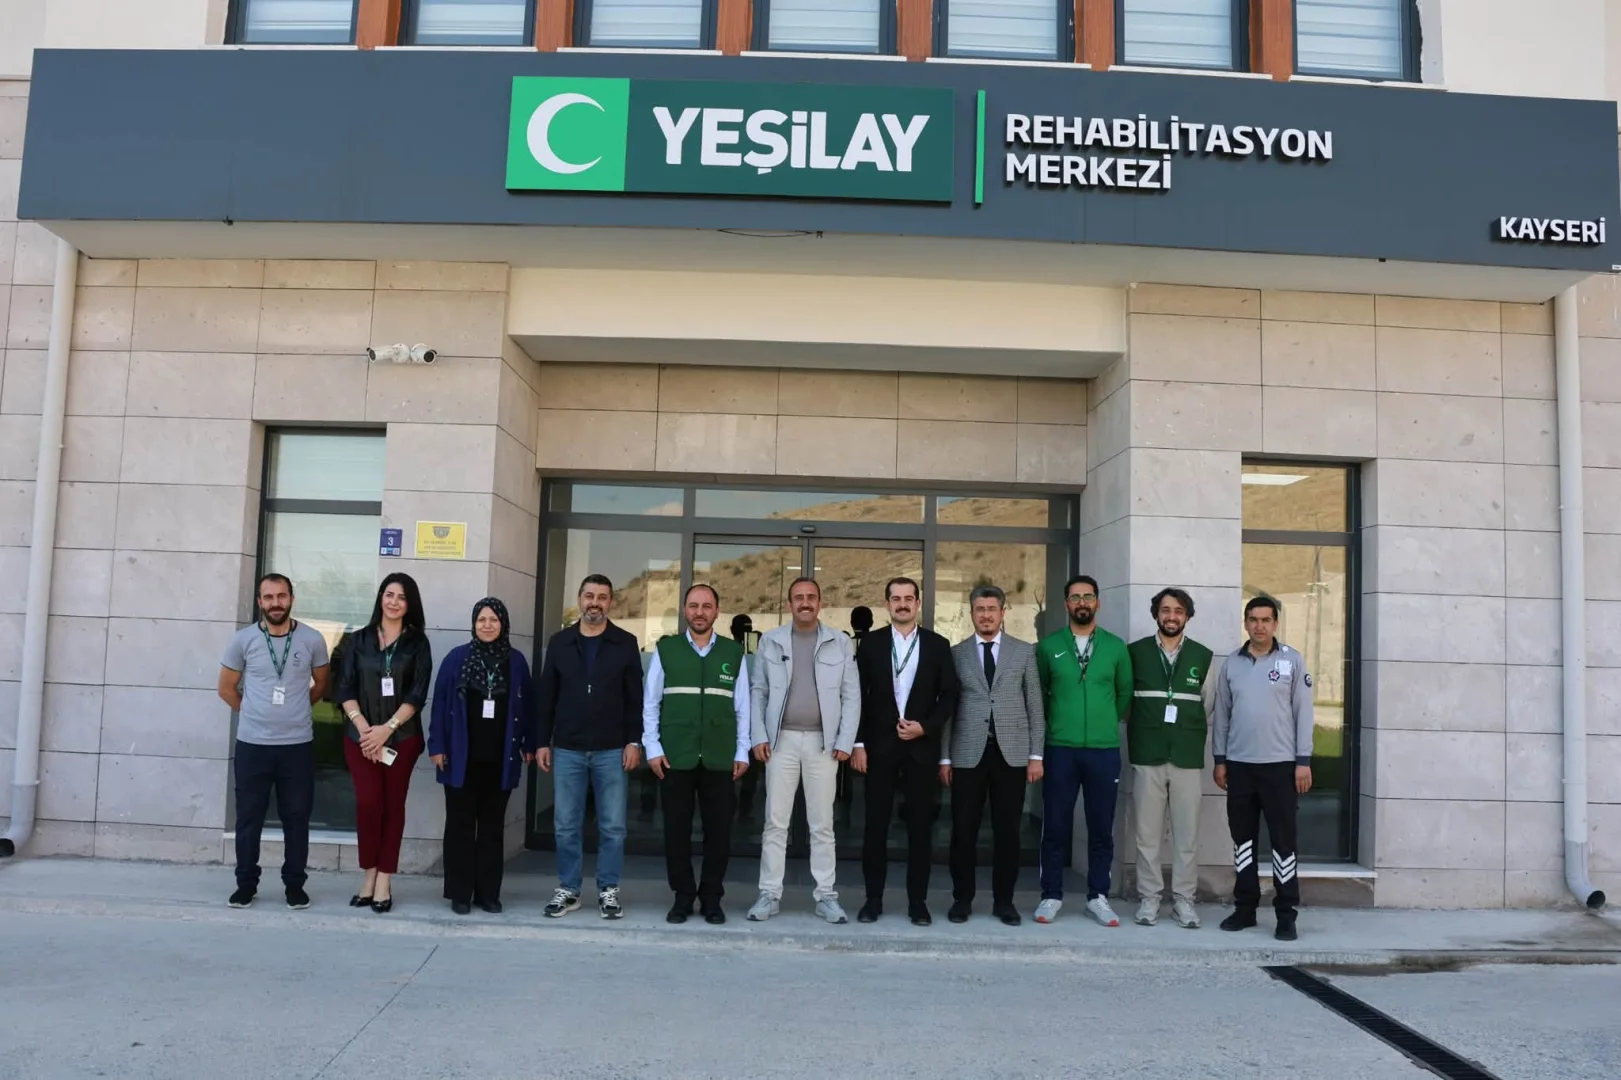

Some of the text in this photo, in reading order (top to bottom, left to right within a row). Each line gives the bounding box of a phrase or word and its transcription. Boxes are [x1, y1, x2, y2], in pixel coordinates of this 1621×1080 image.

[1006, 113, 1333, 159] REHABİLİTASYON
[1006, 152, 1172, 189] MERKEZİ
[1500, 216, 1606, 243] KAYSERİ
[387, 536, 394, 546] 3
